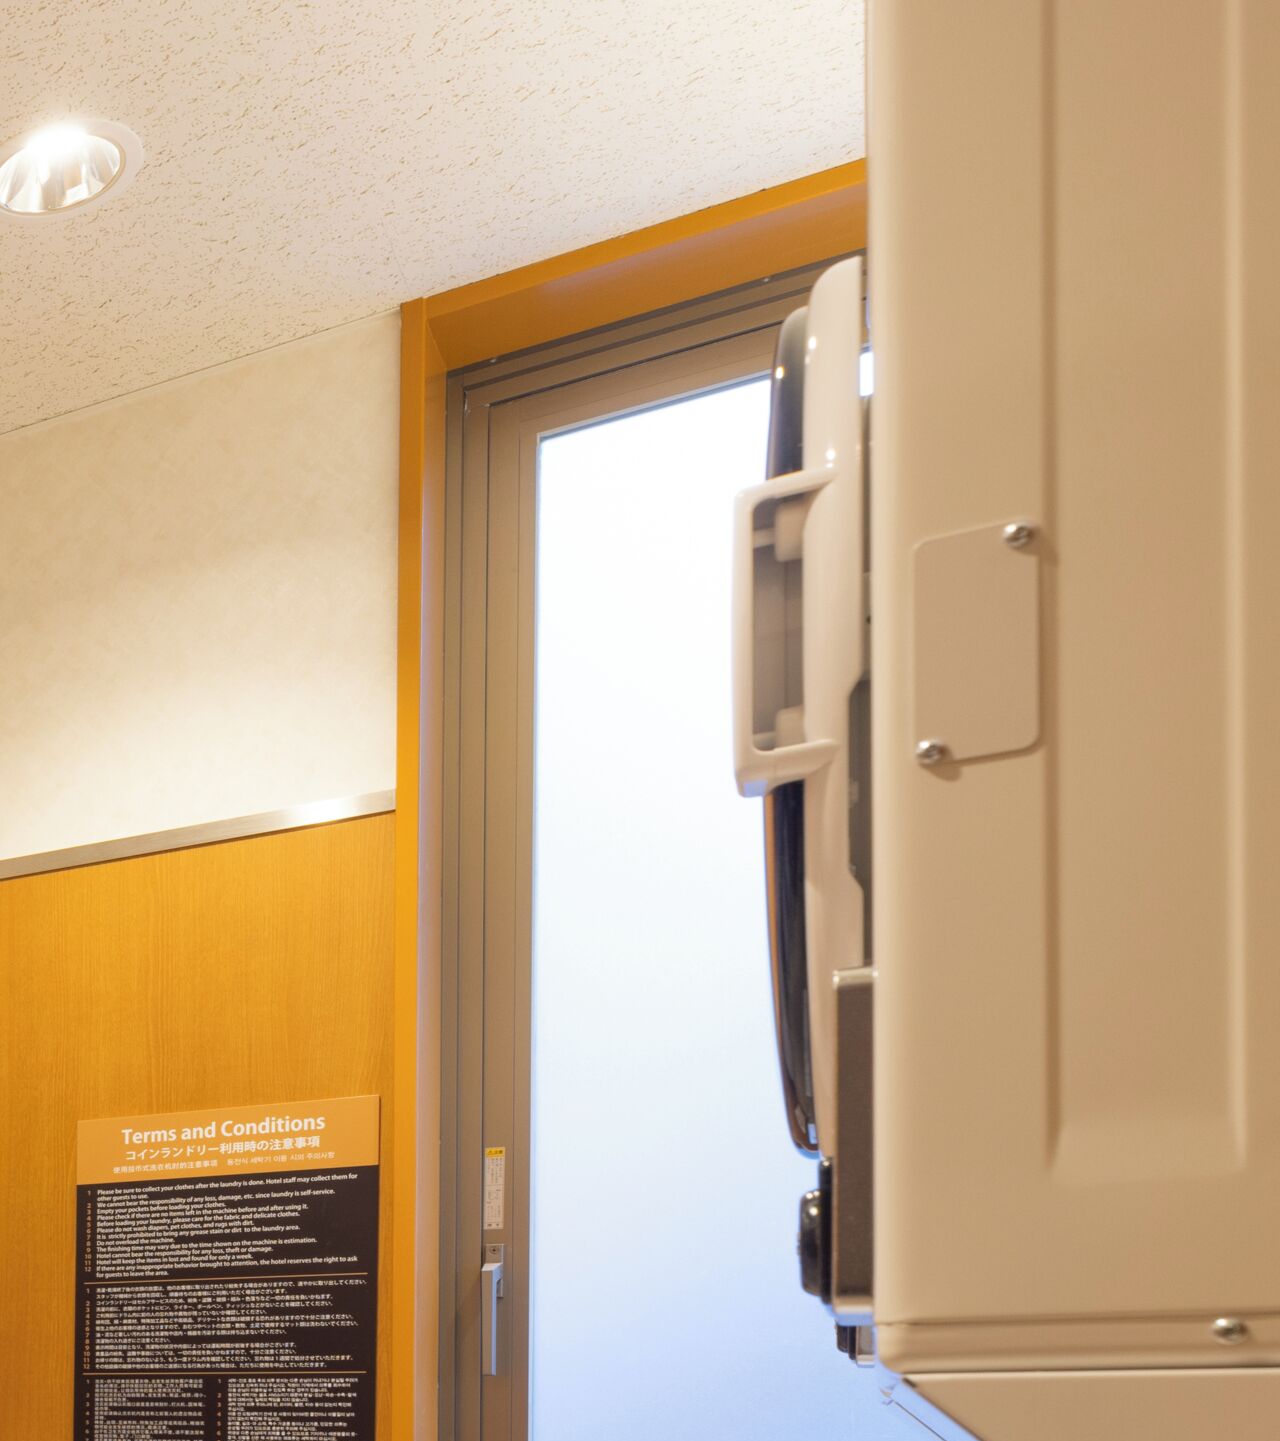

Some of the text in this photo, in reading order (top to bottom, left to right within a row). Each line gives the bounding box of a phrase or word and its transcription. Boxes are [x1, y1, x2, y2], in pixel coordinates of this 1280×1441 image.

[122, 1115, 326, 1145] Terms and Conditions
[125, 1136, 321, 1161] コインランドリー利用時の注意事項
[219, 1180, 241, 1188] laundry
[108, 1232, 126, 1240] strictly
[126, 1231, 155, 1239] prohibited
